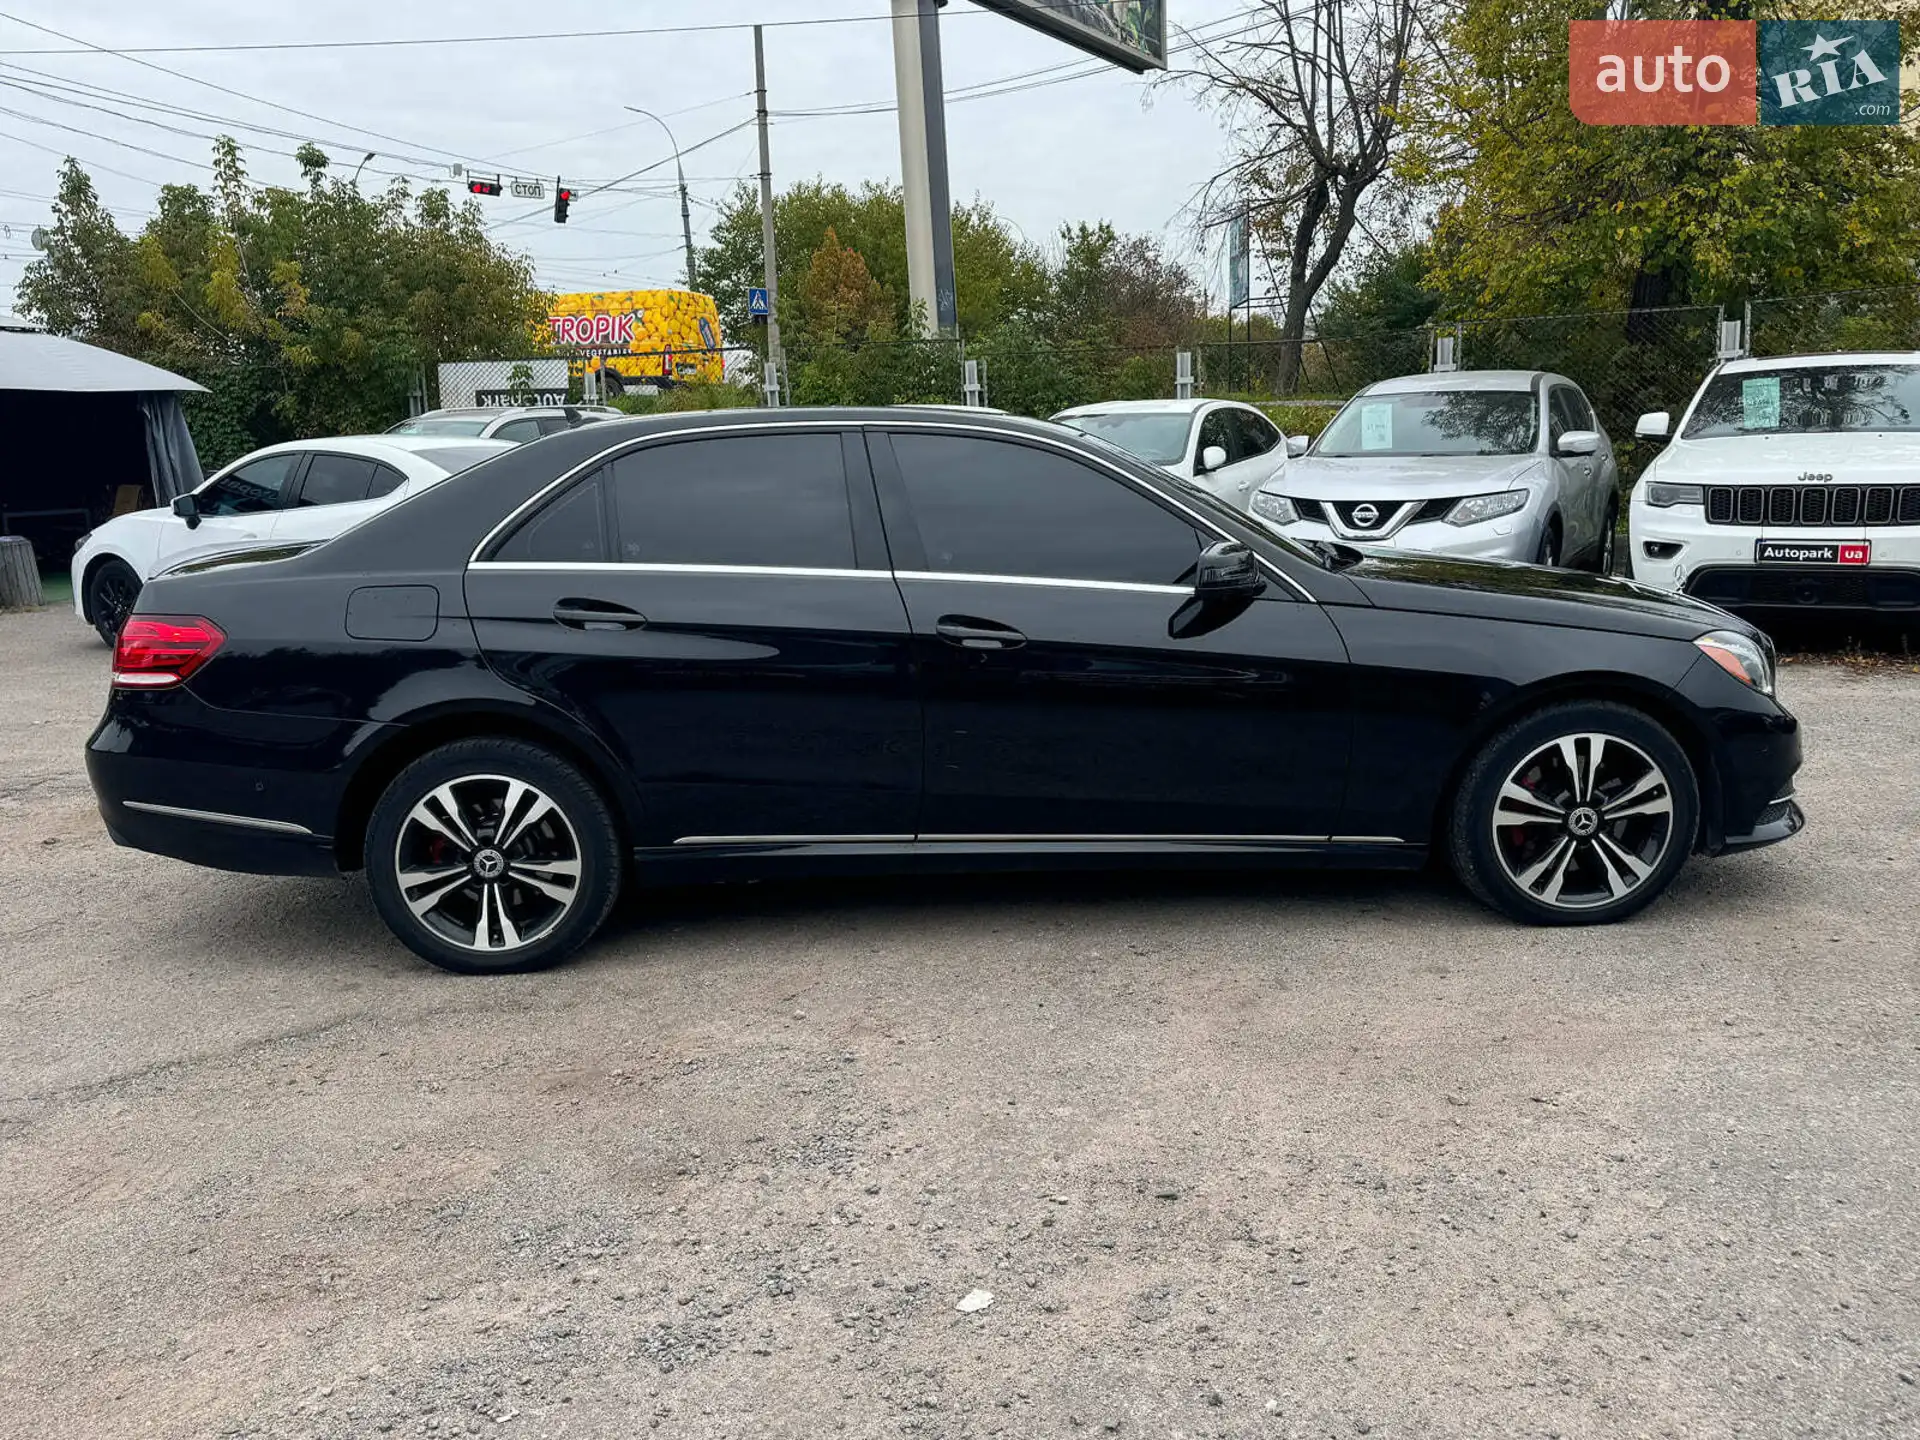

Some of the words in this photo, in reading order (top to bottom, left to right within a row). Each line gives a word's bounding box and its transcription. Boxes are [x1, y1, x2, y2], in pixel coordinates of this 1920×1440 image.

[515, 184, 541, 196] СТОП
[548, 313, 635, 345] TROPIK
[1797, 472, 1833, 483] Jeep
[1763, 546, 1833, 561] Autopark
[1845, 551, 1863, 559] ua
